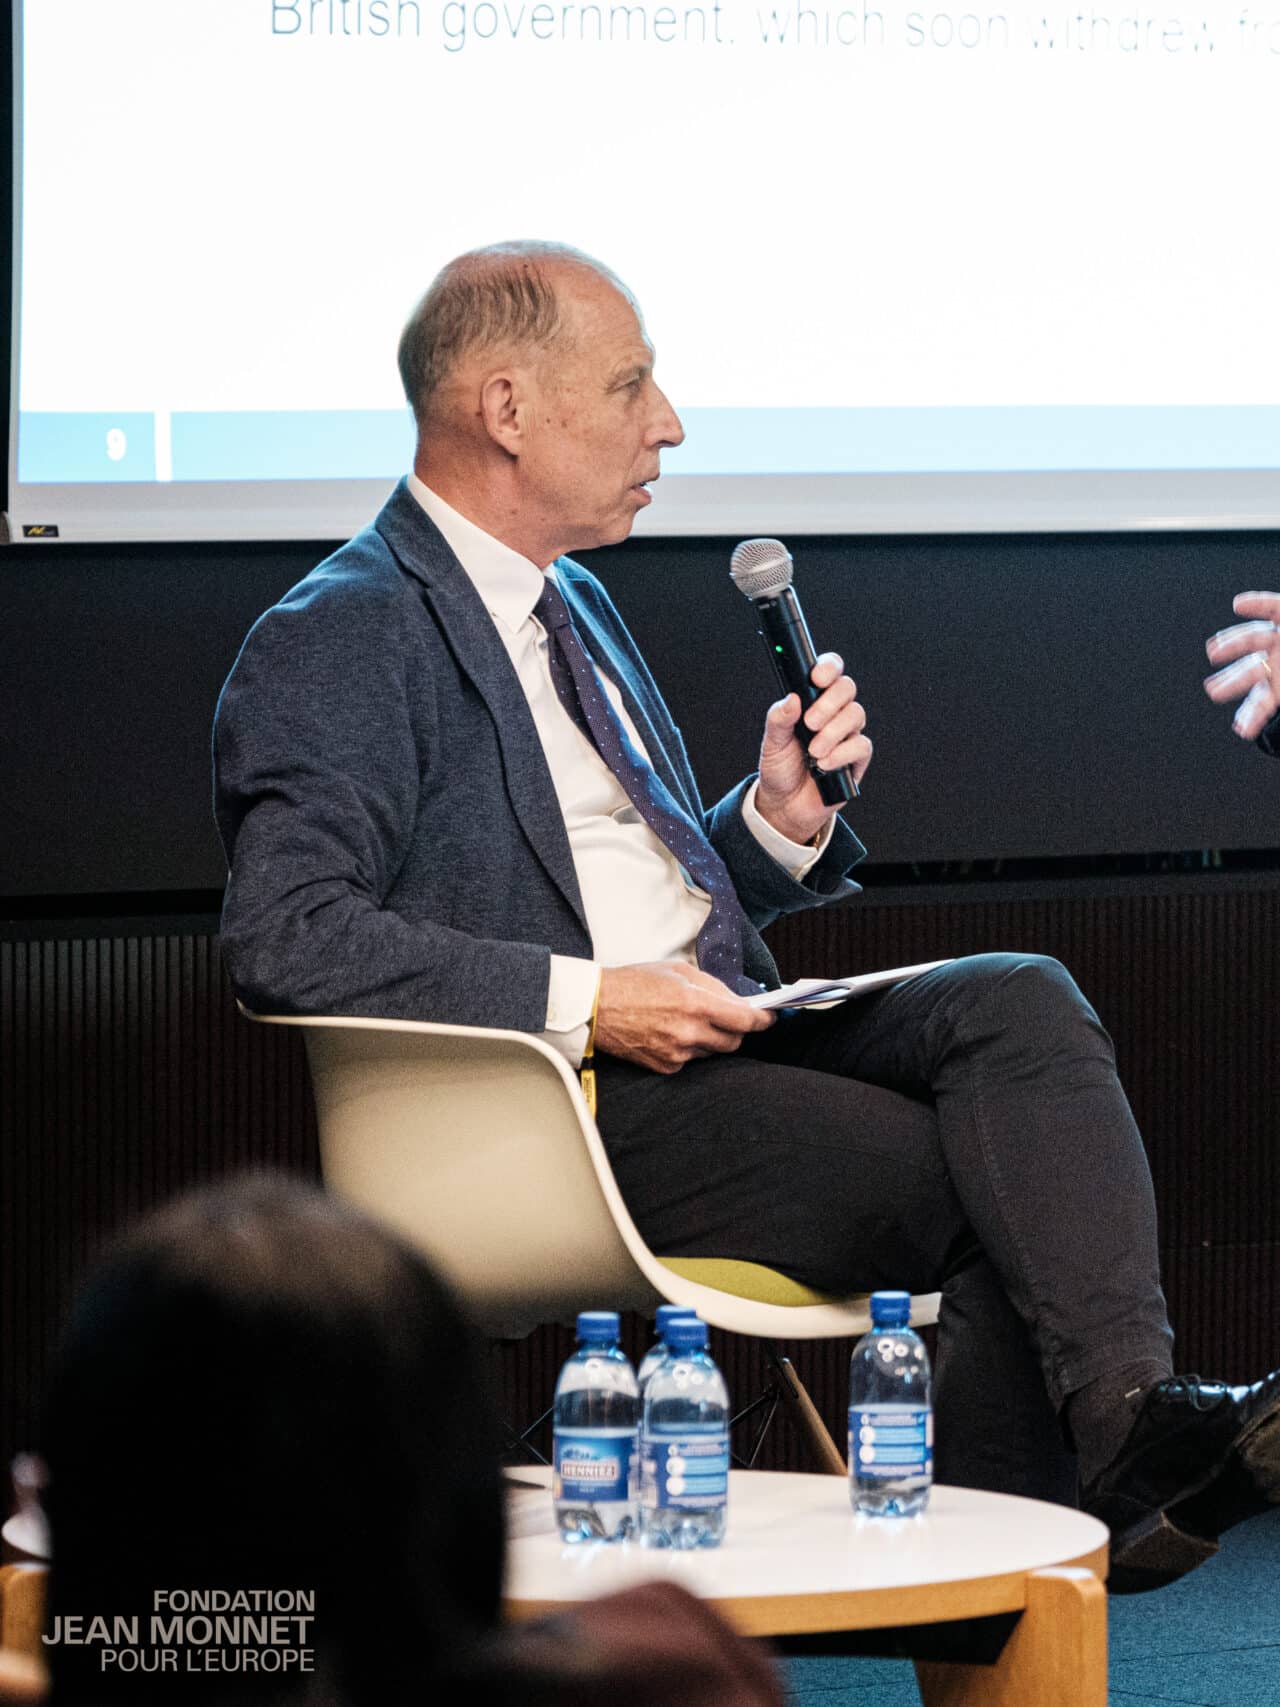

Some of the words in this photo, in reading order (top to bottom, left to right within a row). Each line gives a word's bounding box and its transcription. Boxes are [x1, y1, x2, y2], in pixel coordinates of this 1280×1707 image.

[271, 0, 420, 39] British
[756, 0, 885, 46] which
[904, 12, 1008, 48] soon
[1026, 8, 1218, 54] withdrew
[106, 428, 127, 461] 9
